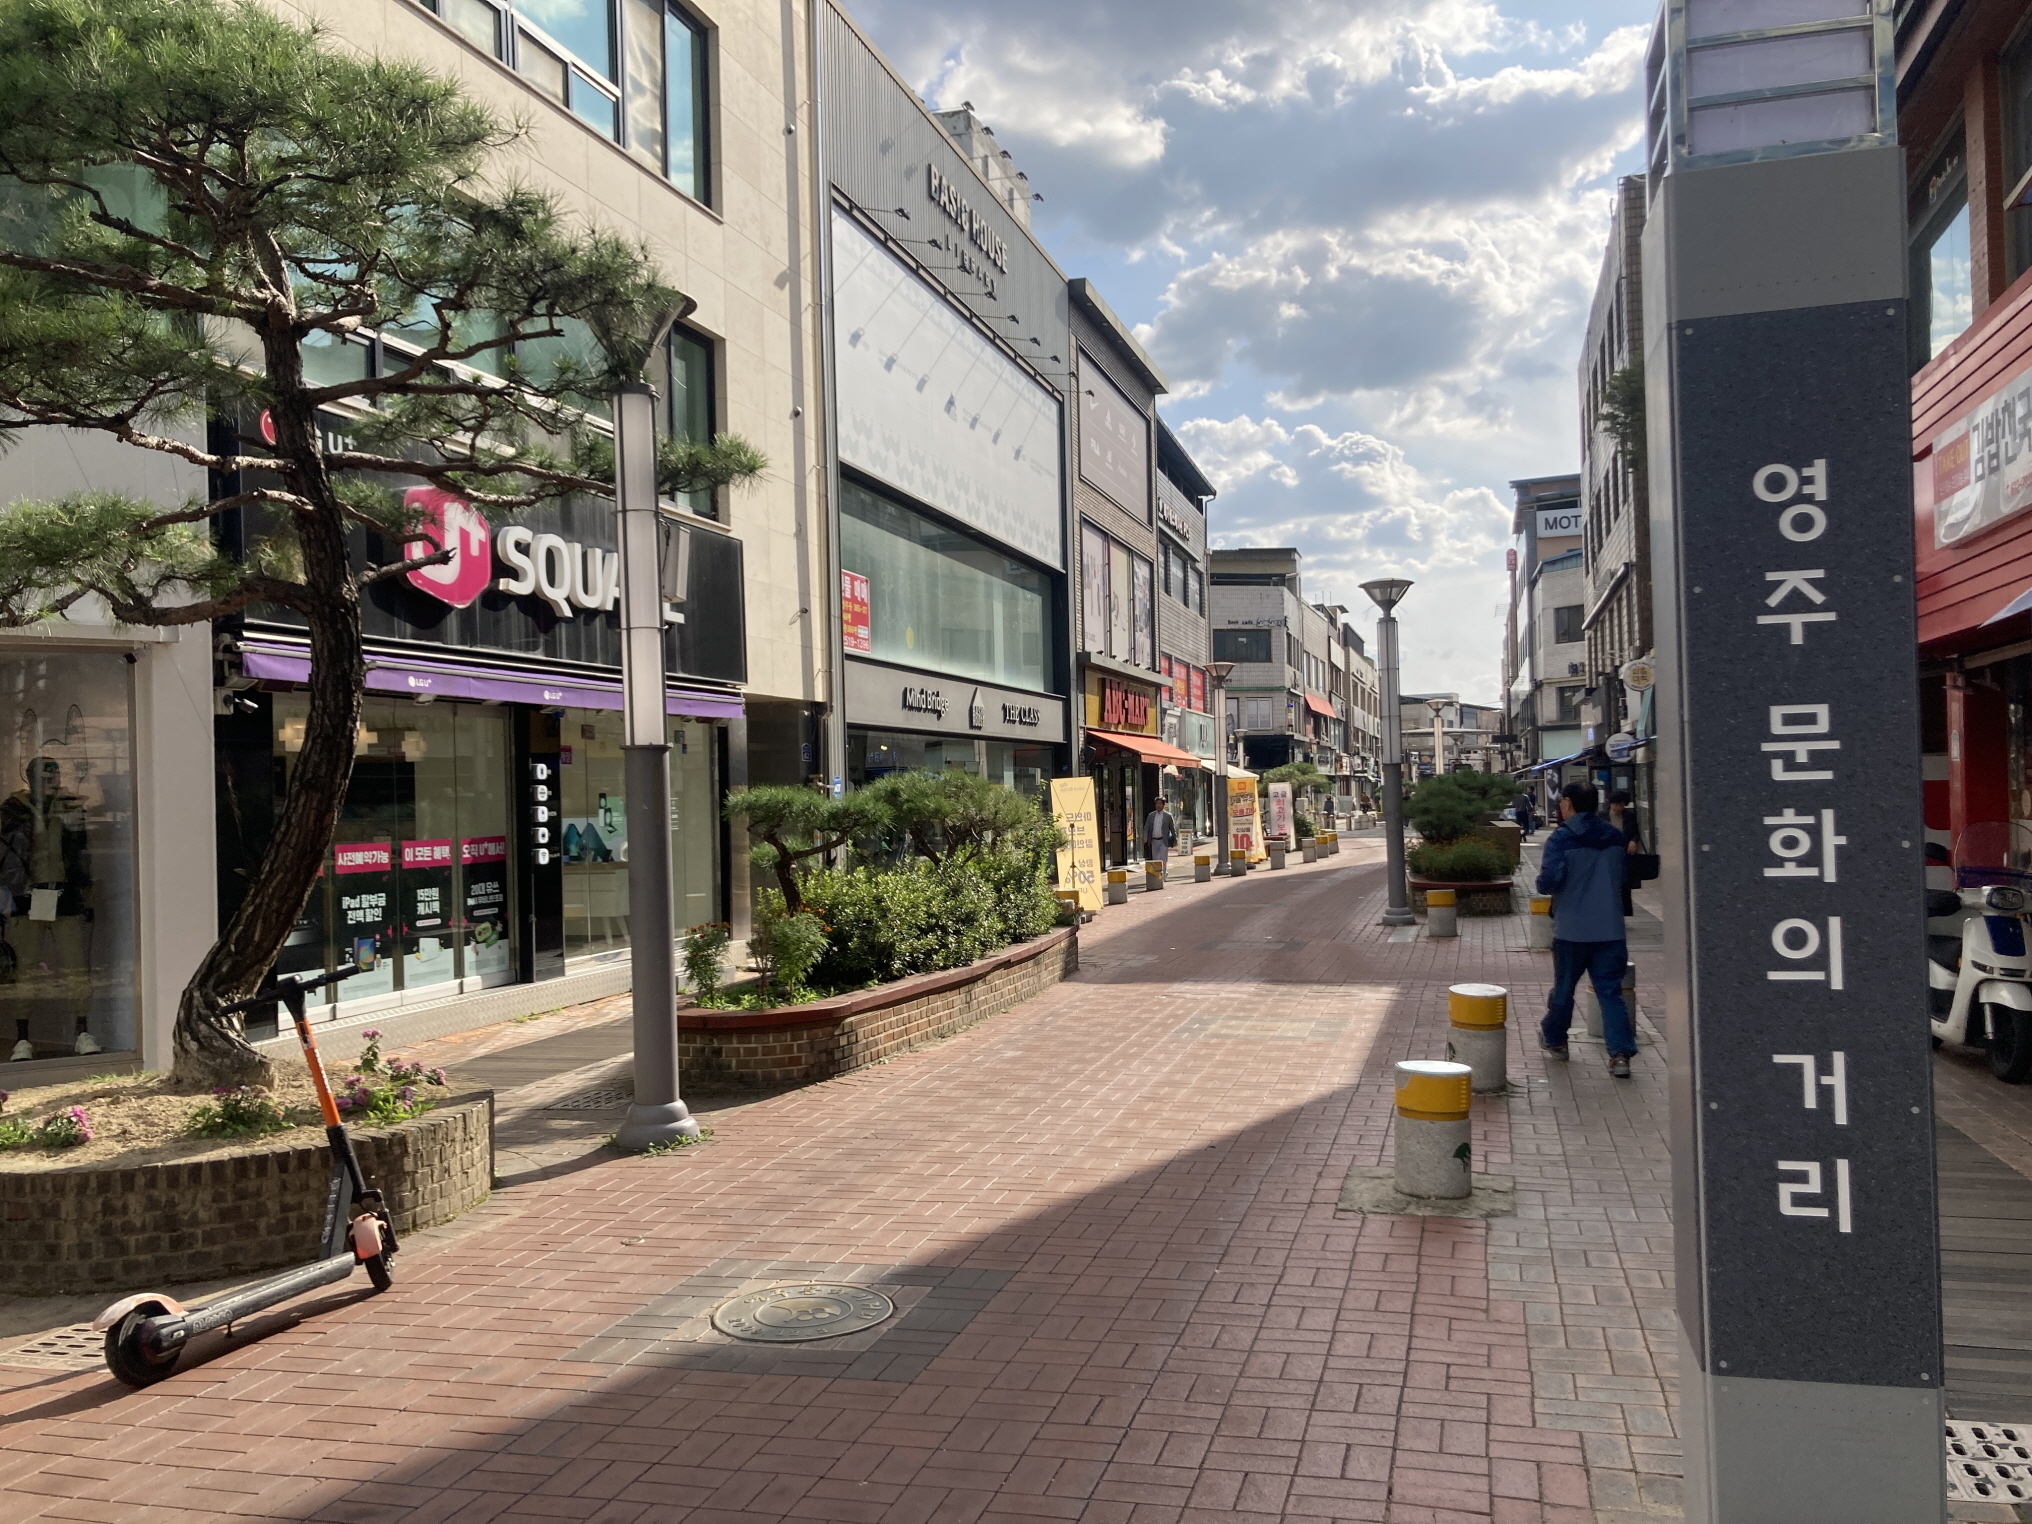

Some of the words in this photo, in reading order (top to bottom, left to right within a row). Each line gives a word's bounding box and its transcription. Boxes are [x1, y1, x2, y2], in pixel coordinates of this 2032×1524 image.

[929, 164, 970, 232] BASIC
[971, 208, 1008, 275] HOUSE
[1752, 458, 1837, 645] 영주
[905, 686, 926, 710] Mind
[927, 690, 949, 717] Bridge
[1004, 702, 1019, 721] THE
[1020, 705, 1040, 724] CLASS
[404, 847, 414, 862] 이
[415, 846, 432, 861] 모든
[462, 843, 478, 858] 오직
[1760, 703, 1848, 990] 문화의
[337, 850, 389, 866] 사전예약가능
[342, 895, 361, 909] iPad
[361, 892, 386, 909] 할부금
[416, 887, 440, 901] 15만원
[346, 909, 364, 925] 전액
[365, 907, 382, 922] 할인
[416, 900, 440, 915] 캐시백
[1771, 1051, 1852, 1233] 거리
